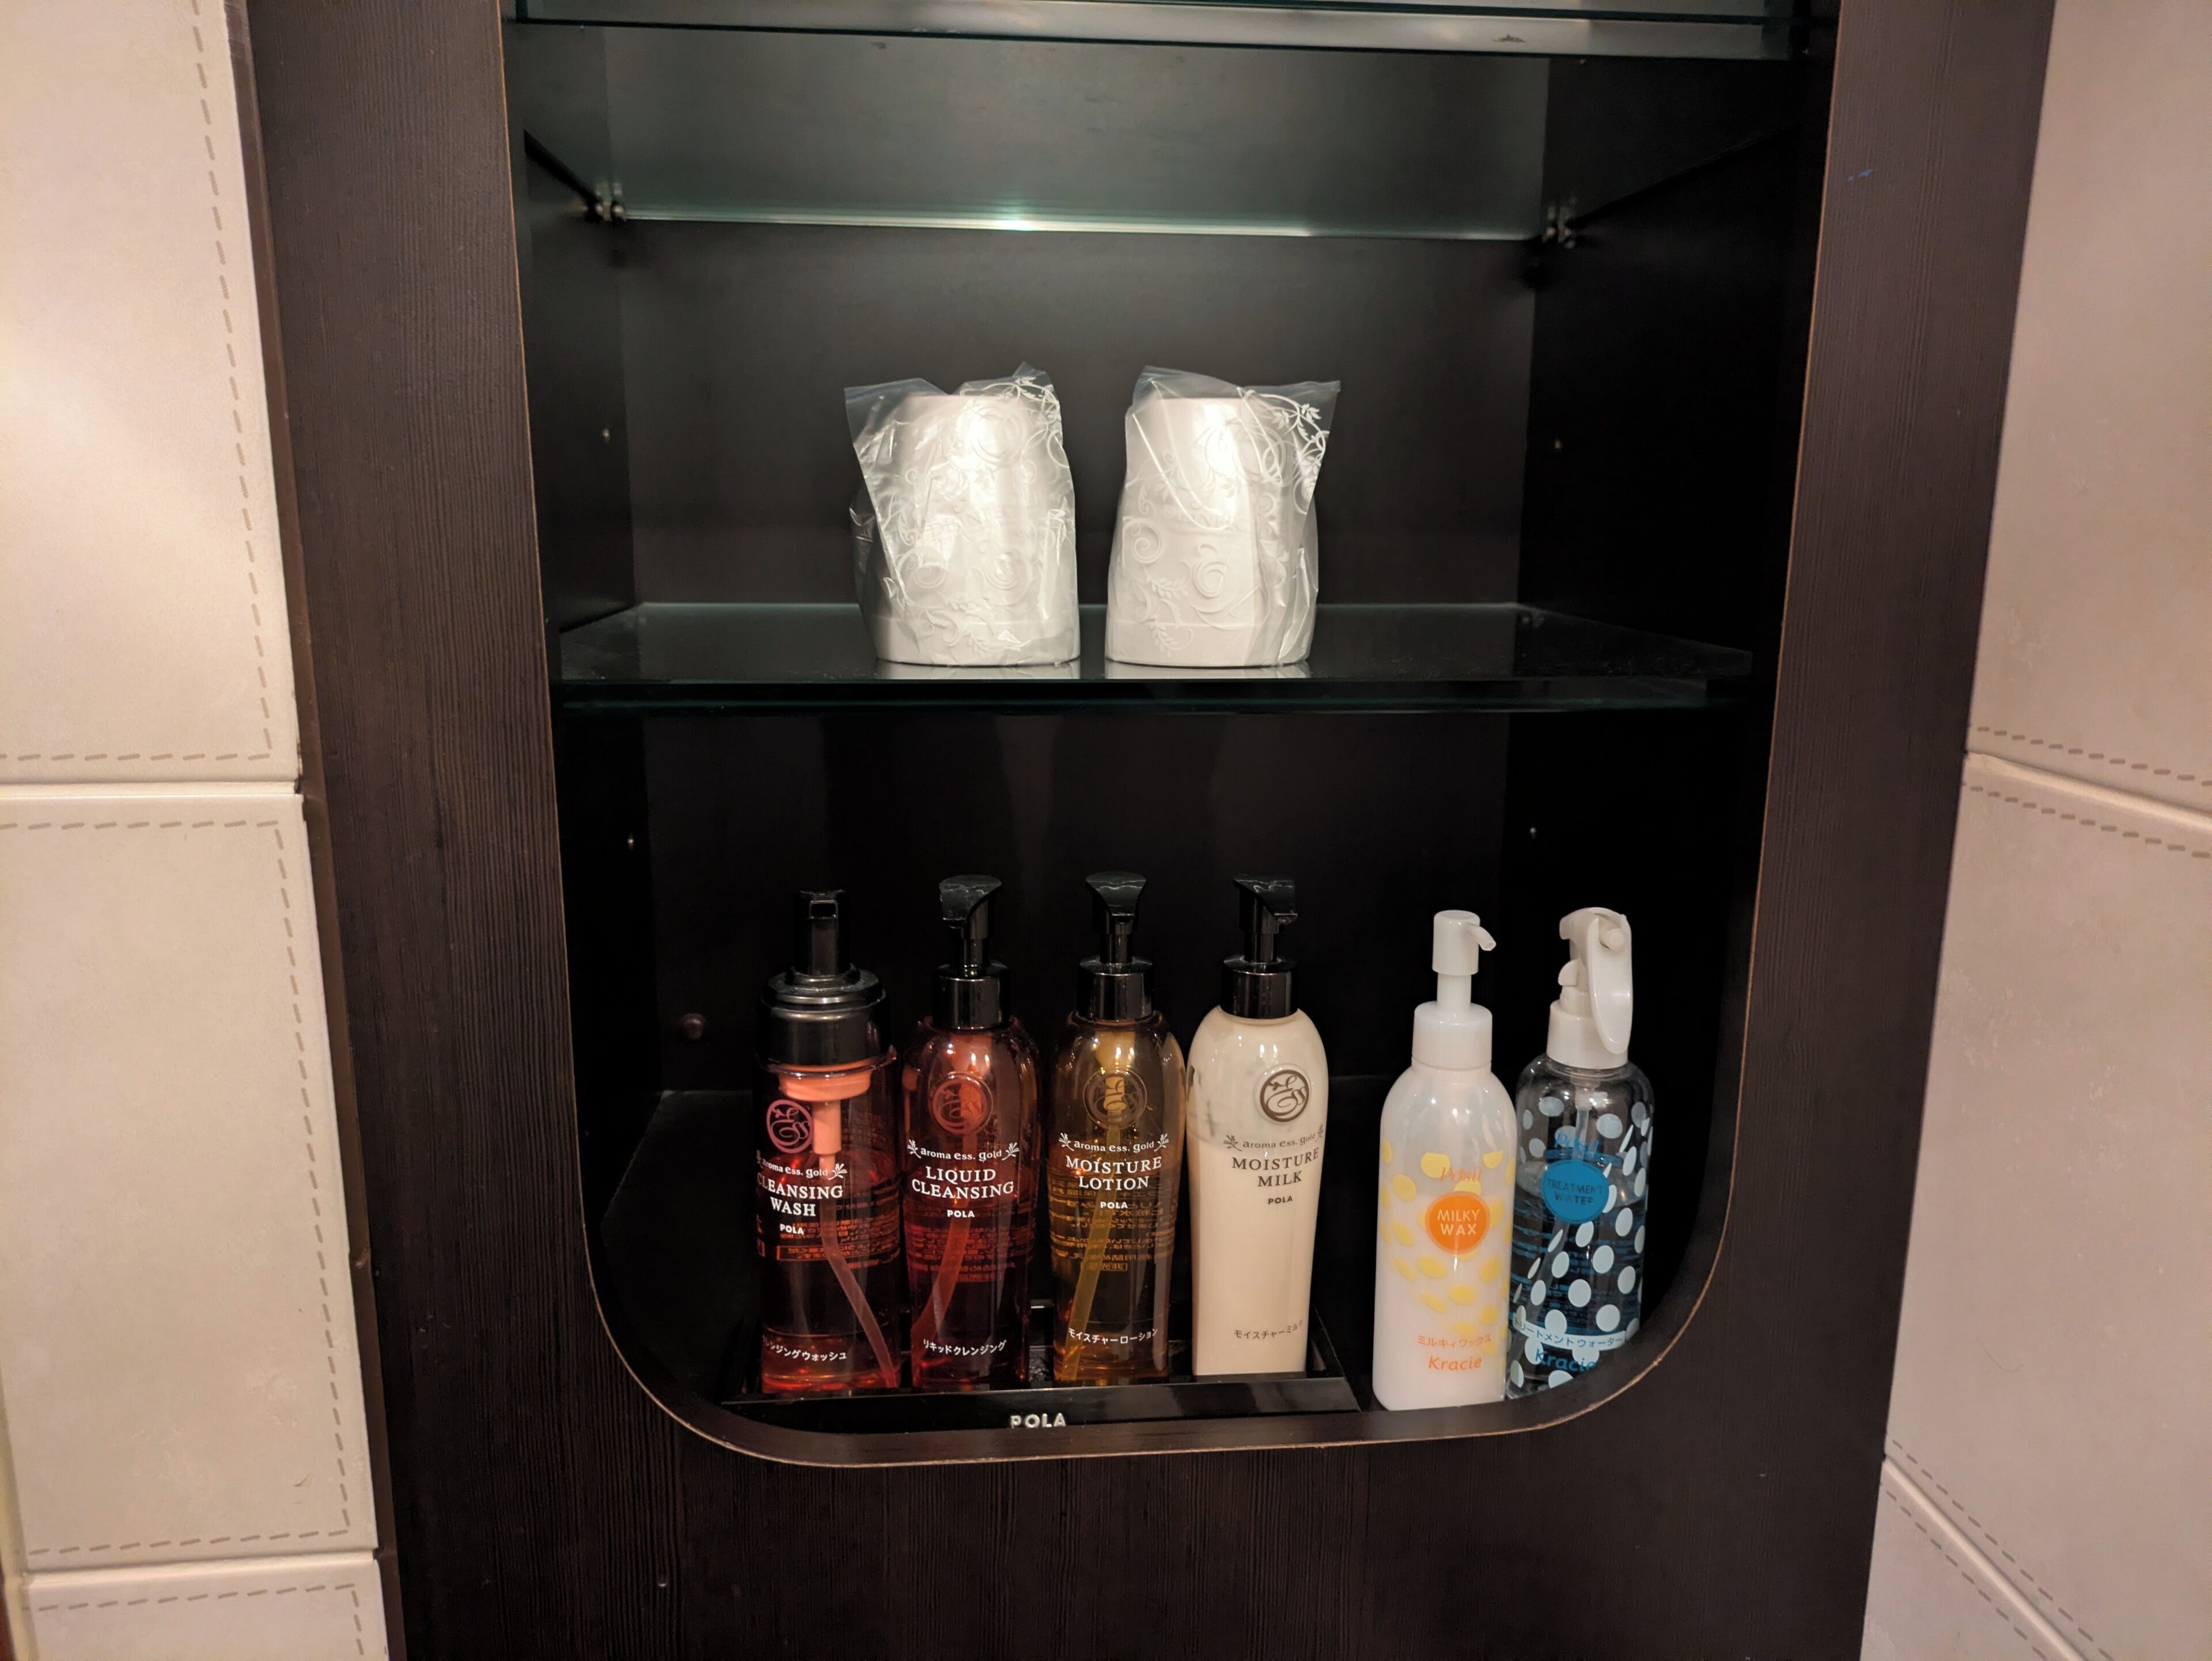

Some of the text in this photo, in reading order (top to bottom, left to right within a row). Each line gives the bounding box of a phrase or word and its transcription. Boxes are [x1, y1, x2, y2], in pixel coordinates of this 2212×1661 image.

[1074, 1140, 1106, 1152] aroma
[1134, 1141, 1154, 1153] gold
[1243, 1140, 1277, 1148] aroma
[1300, 1133, 1316, 1146] gold
[921, 1147, 1002, 1163] aroma ess. gold
[1232, 1147, 1320, 1171] MOISTURE
[762, 1158, 828, 1178] aroma ess. gold
[1066, 1155, 1162, 1175] MOISTURE
[925, 1166, 997, 1185] LIQUID
[1078, 1175, 1149, 1191] LOTION
[1257, 1171, 1303, 1187] MILK
[757, 1172, 843, 1200] CLEANSING
[912, 1179, 1014, 1200] CLEANSING
[770, 1197, 816, 1217] WASH
[1268, 1195, 1293, 1205] POLA
[947, 1210, 975, 1218] POLA
[1437, 1209, 1480, 1221] MILKY
[779, 1223, 805, 1235] POLA
[1440, 1223, 1476, 1236] WAX
[1068, 1327, 1158, 1345] モイスチャーローション
[923, 1338, 1007, 1356] リキッドクレンジング
[1429, 1356, 1482, 1371] Kracie
[1535, 1348, 1596, 1372] Kracie
[1010, 1413, 1066, 1429] POLA
